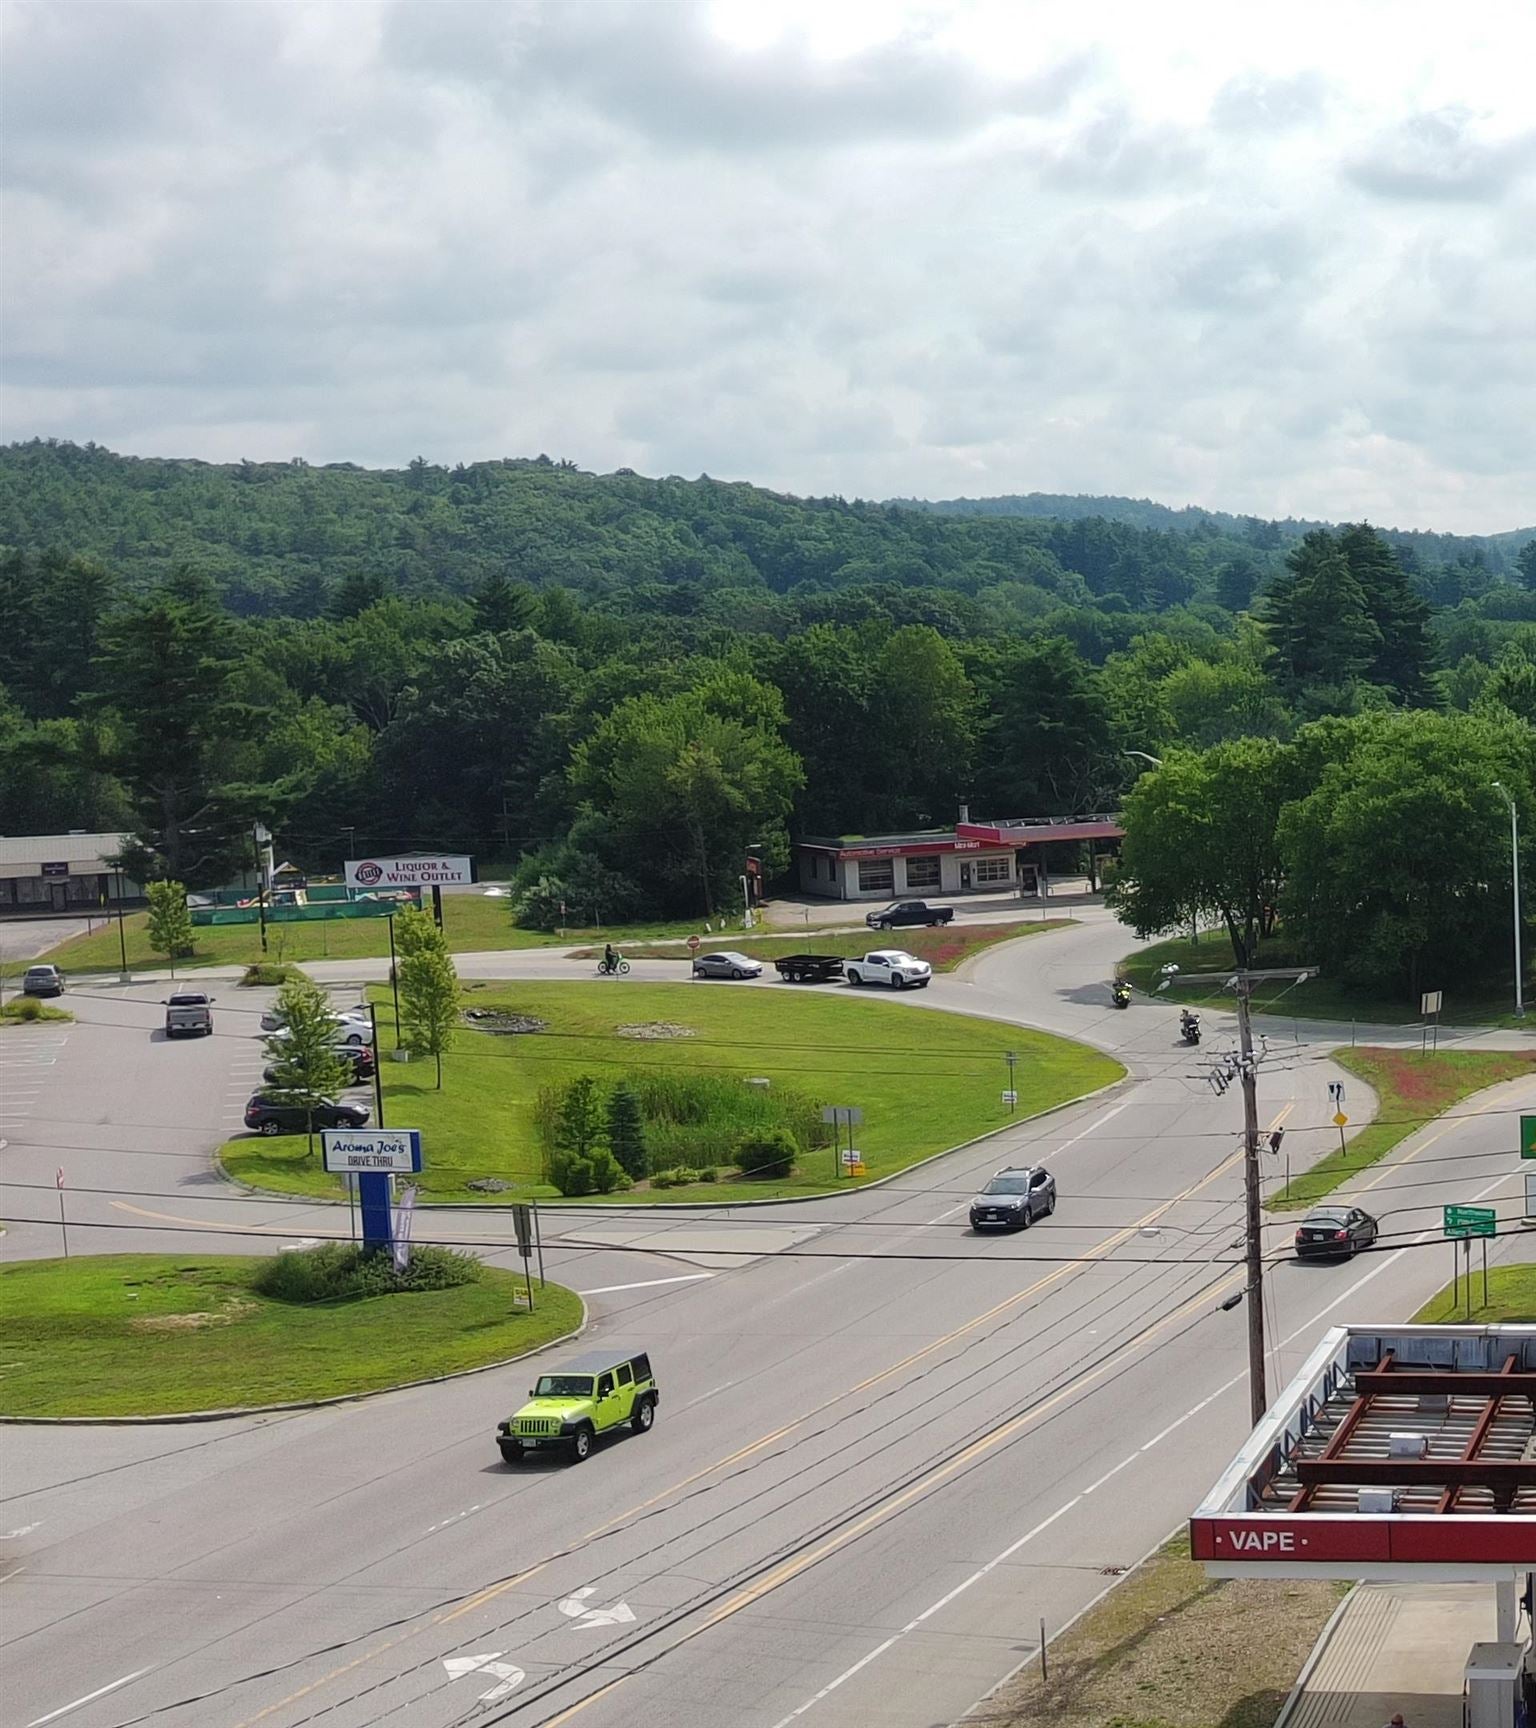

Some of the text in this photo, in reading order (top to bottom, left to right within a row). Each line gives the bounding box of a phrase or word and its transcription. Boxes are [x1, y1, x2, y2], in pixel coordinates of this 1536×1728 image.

[332, 1141, 373, 1153] Aroma
[348, 1156, 393, 1167] DRIVE THRU
[1229, 1531, 1295, 1551] VAPE
